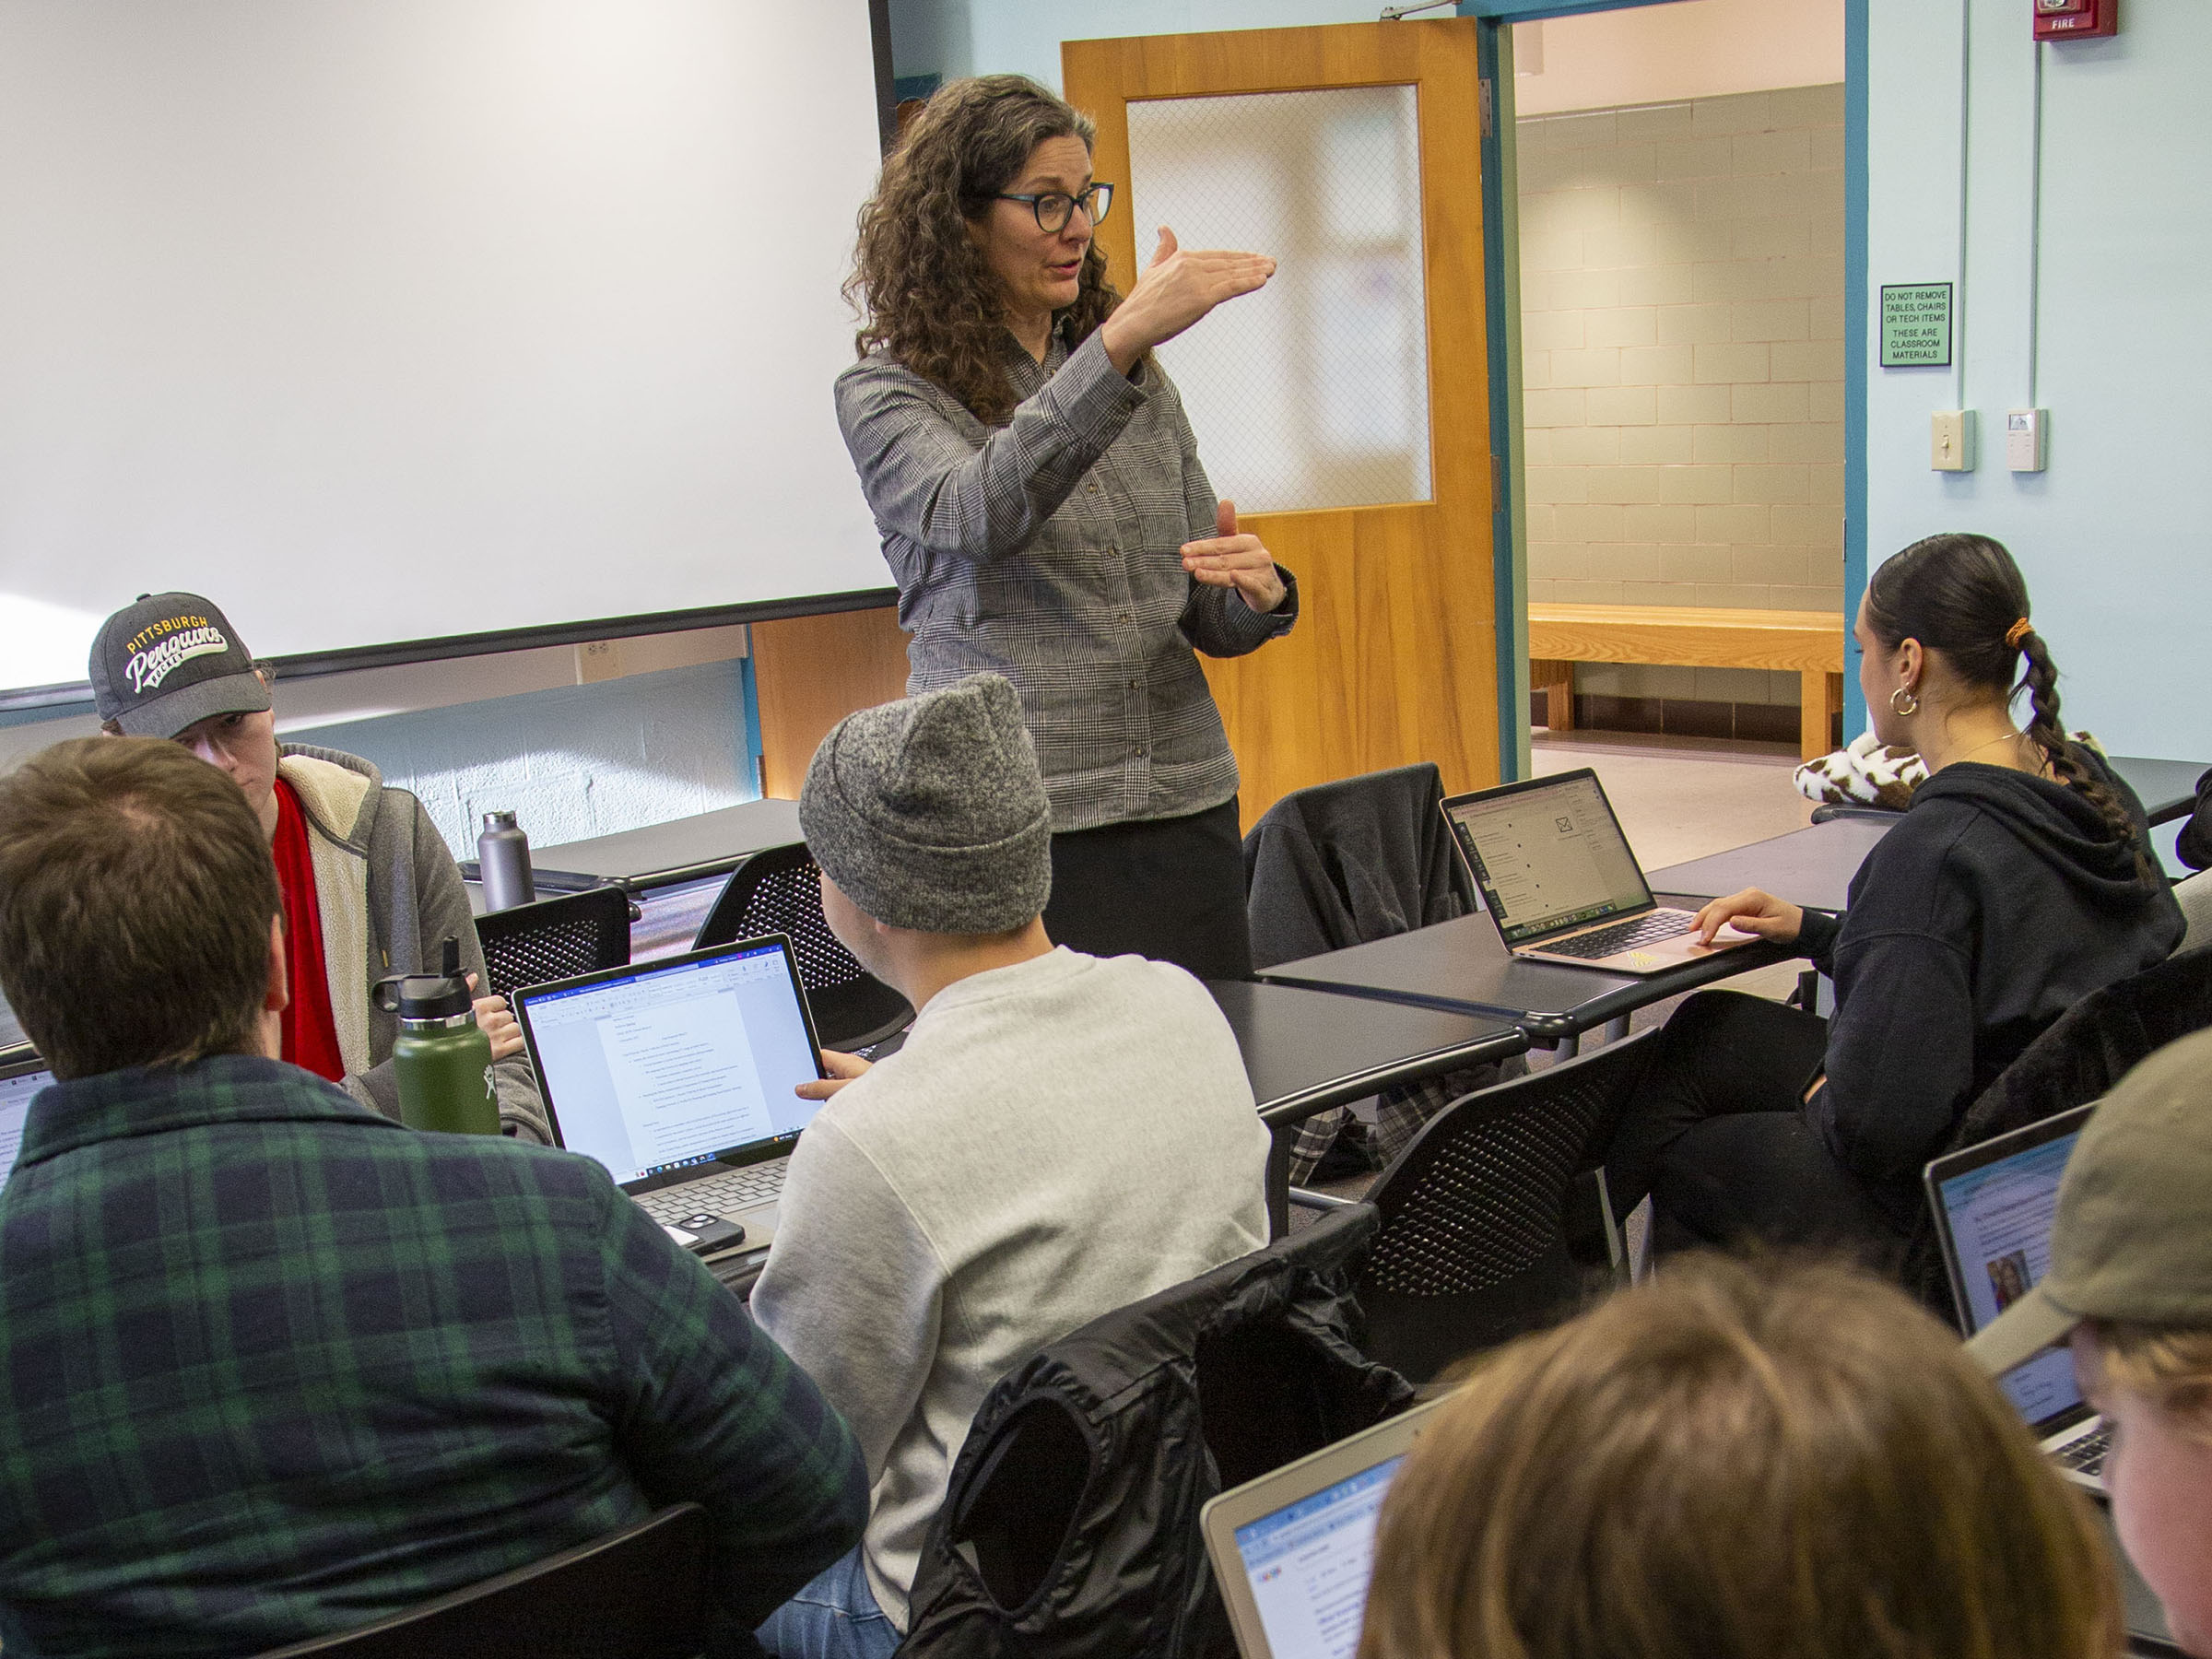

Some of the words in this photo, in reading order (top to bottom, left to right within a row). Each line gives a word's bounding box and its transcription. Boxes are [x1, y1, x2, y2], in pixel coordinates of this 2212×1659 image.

[2052, 18, 2075, 29] FIRE
[1885, 293, 1896, 301] DO
[1898, 292, 1913, 300] NOT
[1915, 291, 1947, 300] REMOVE
[1886, 303, 1915, 312] TABLES,
[1917, 302, 1947, 311] CHAIRS
[1886, 315, 1897, 324] OR
[1899, 314, 1919, 323] TECH
[1922, 313, 1946, 323] ITEMS
[1893, 329, 1919, 337] THESE
[1921, 328, 1937, 336] ARE
[1890, 339, 1940, 348] CLASSROOM
[1892, 350, 1938, 359] MATERIALS
[126, 615, 208, 655] PITTSBURGH
[125, 627, 225, 694] Penguins
[151, 652, 184, 684] HOCKEY
